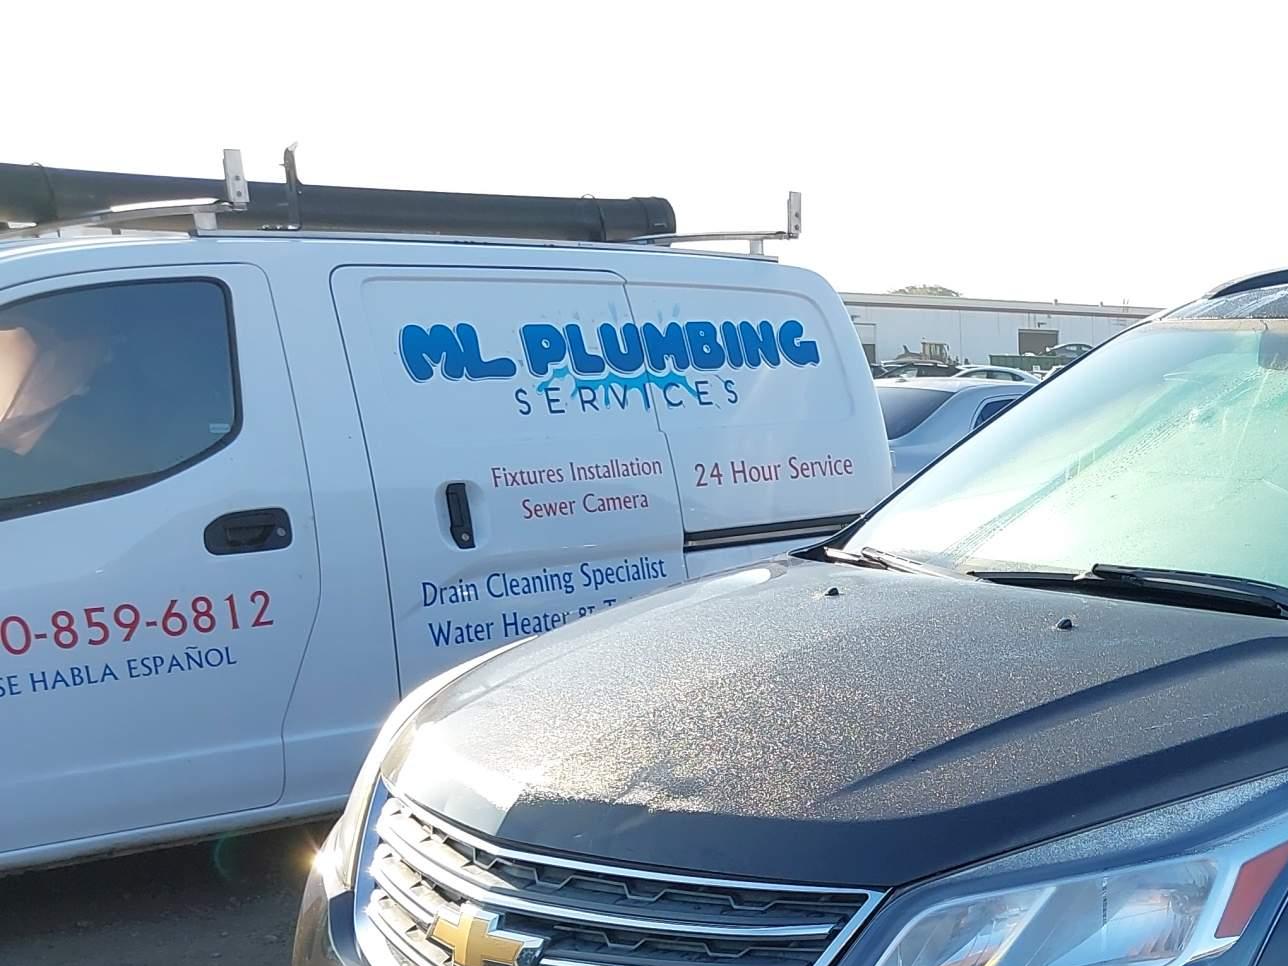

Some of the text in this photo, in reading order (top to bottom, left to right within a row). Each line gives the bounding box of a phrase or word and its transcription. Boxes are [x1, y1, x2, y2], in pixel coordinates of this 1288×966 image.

[399, 320, 820, 383] ML PLUMBING
[515, 379, 739, 416] SERVICES
[490, 457, 662, 489] Fixtures Installation
[694, 454, 853, 487] 24 Hour Service
[522, 491, 649, 519] Sewer Camera
[421, 557, 667, 607] Drain Cleaning Specialist
[428, 620, 494, 647] Water
[502, 611, 570, 638] Heater
[29, 663, 118, 692] HABLA
[127, 646, 237, 678] ESPAÑOL
